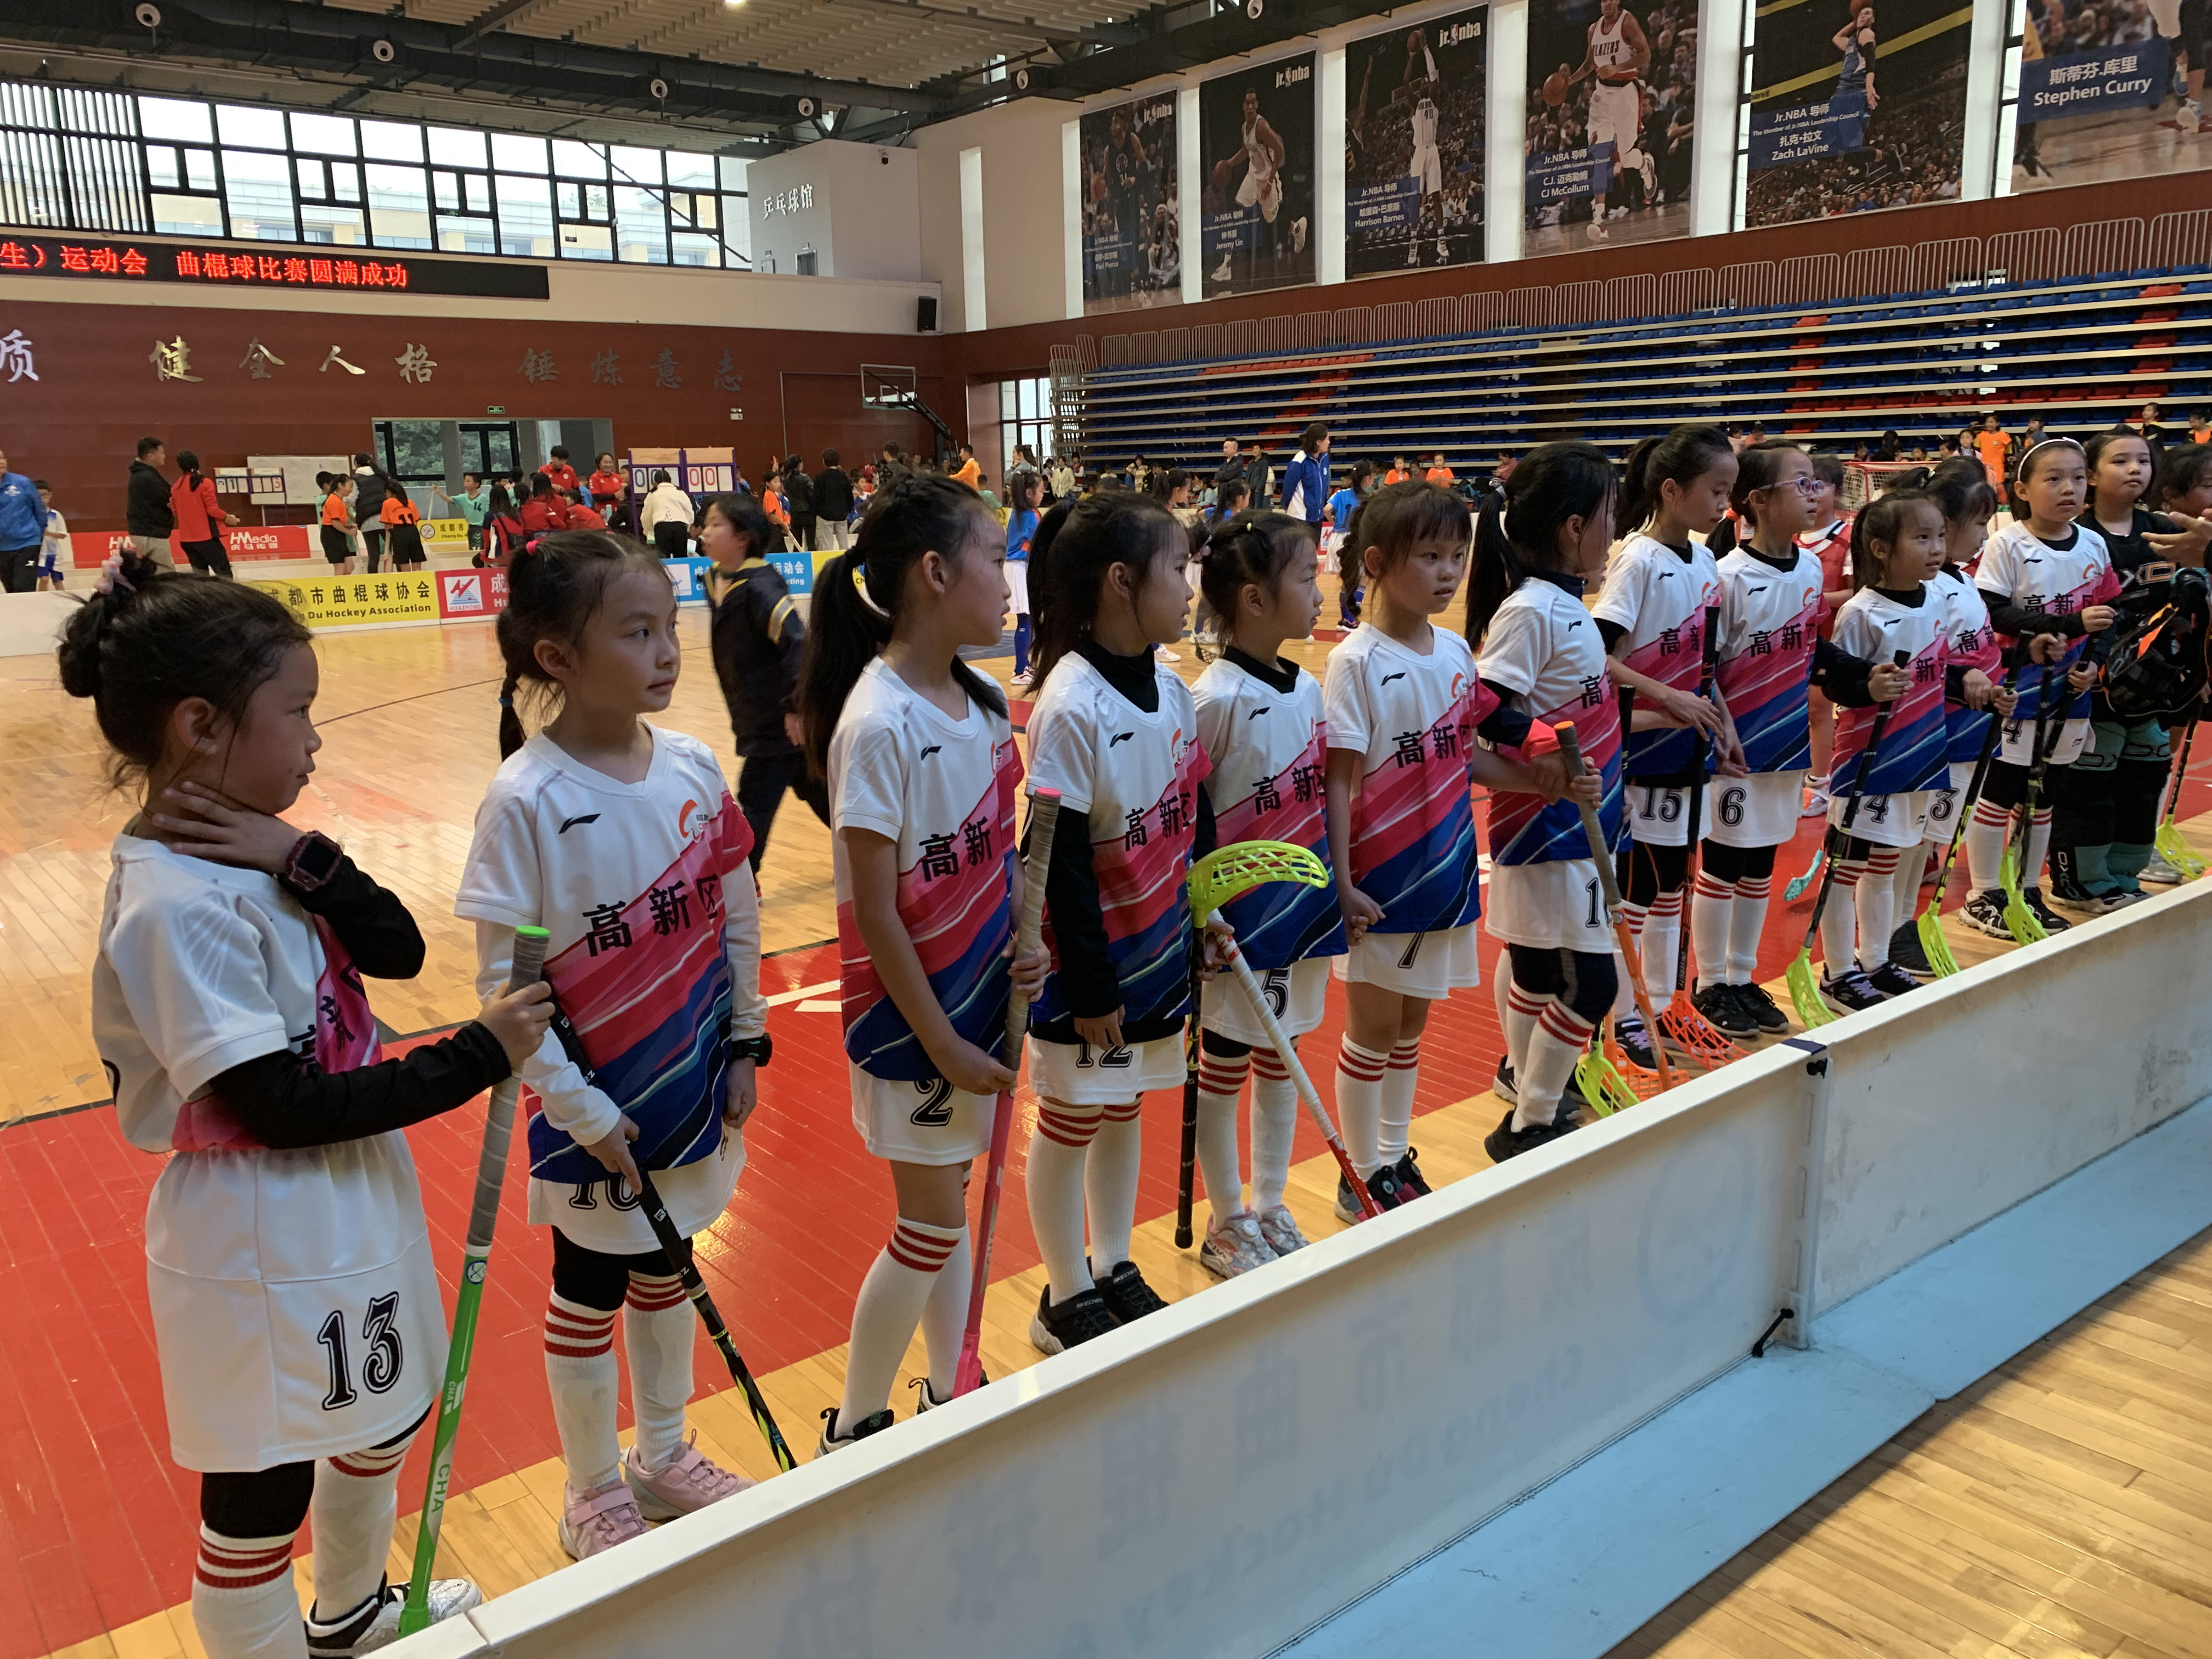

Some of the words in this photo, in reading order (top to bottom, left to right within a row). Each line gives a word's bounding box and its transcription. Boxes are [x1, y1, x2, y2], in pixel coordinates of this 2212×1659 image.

[2034, 86, 2100, 106] Stephen
[2105, 78, 2153, 94] Curry
[1774, 108, 1807, 123] Jr.NBA
[1809, 103, 1830, 116] 导师
[1839, 111, 1860, 120] Council
[1544, 152, 1570, 164] Jr.NBA
[1771, 148, 1794, 161] Zach
[1797, 144, 1829, 157] LaVine
[1361, 186, 1383, 196] Jr.NBA
[1541, 189, 1549, 198] CJ
[1551, 184, 1589, 196] McCollum
[763, 184, 812, 220] 乒乓球馆
[1355, 218, 1381, 228] Harrison
[1383, 214, 1404, 223] Barnes
[176, 251, 408, 288] 曲棍球比赛圆满成功
[474, 501, 482, 511] 14
[308, 611, 323, 619] Du
[326, 608, 366, 618] Hockey
[369, 604, 432, 616] Association
[1639, 787, 1683, 823] 15
[1718, 786, 1747, 827] 6
[1930, 787, 1960, 821] 3
[910, 1077, 955, 1127] 2
[318, 1291, 403, 1411] 13
